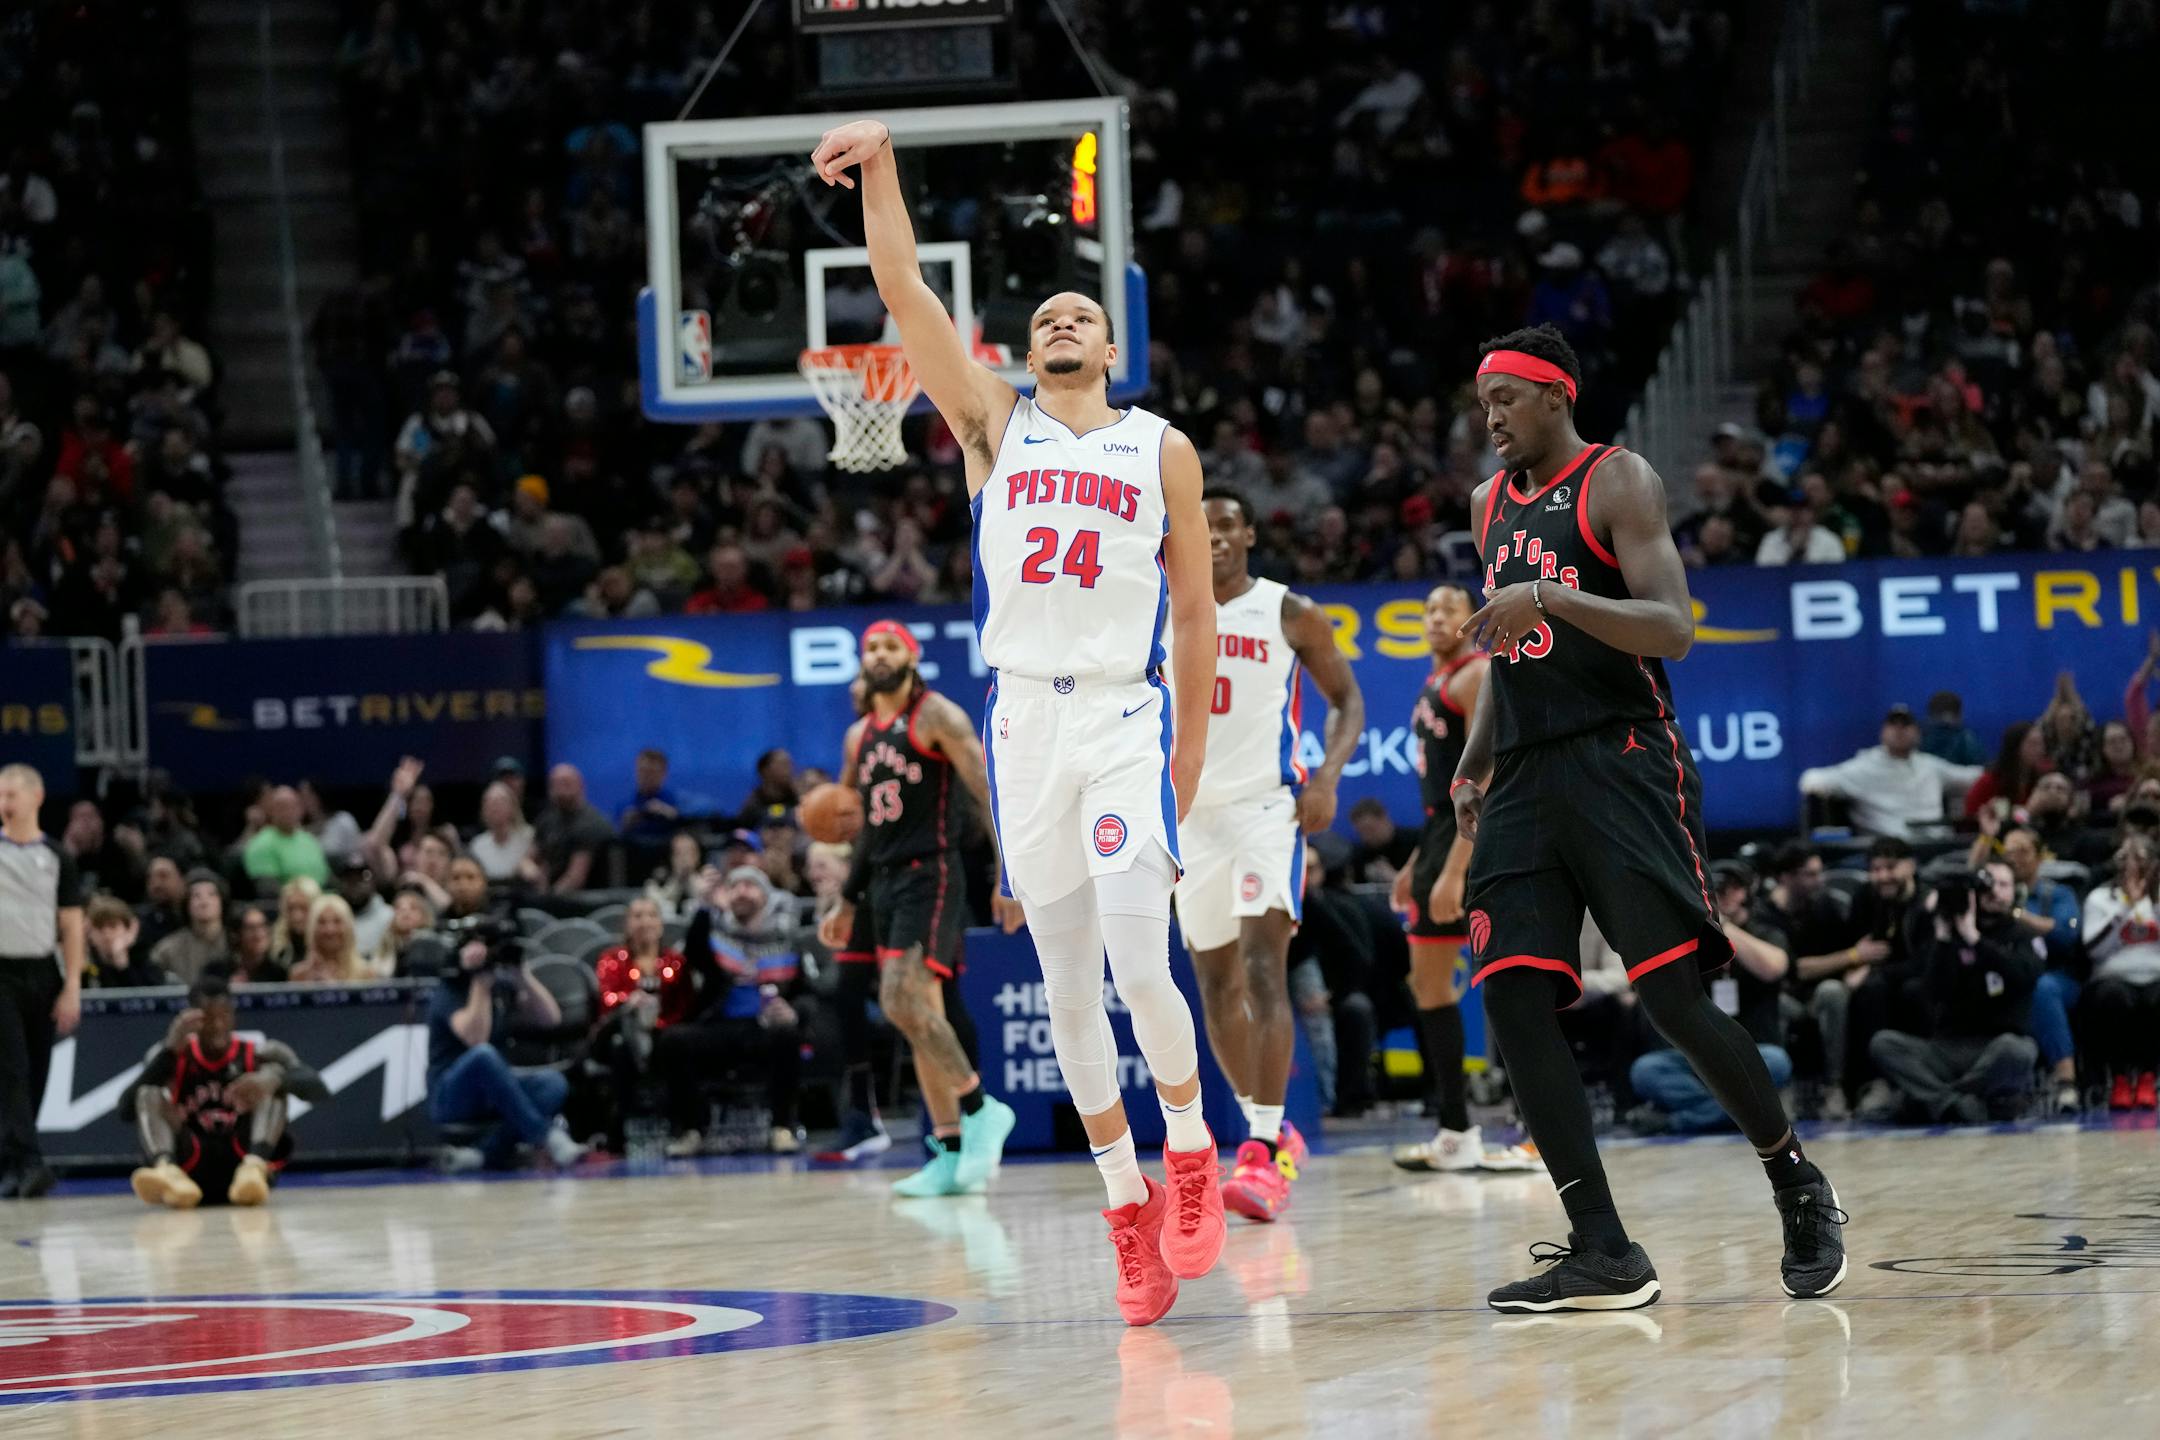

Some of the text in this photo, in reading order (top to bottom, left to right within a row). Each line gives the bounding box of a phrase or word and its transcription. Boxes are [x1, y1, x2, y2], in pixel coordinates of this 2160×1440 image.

[1103, 443, 1139, 454] UWM
[1007, 469, 1142, 523] PISTONS
[1559, 502, 1571, 510] Life
[1021, 526, 1103, 589] 24
[1790, 565, 2160, 640] BETRI
